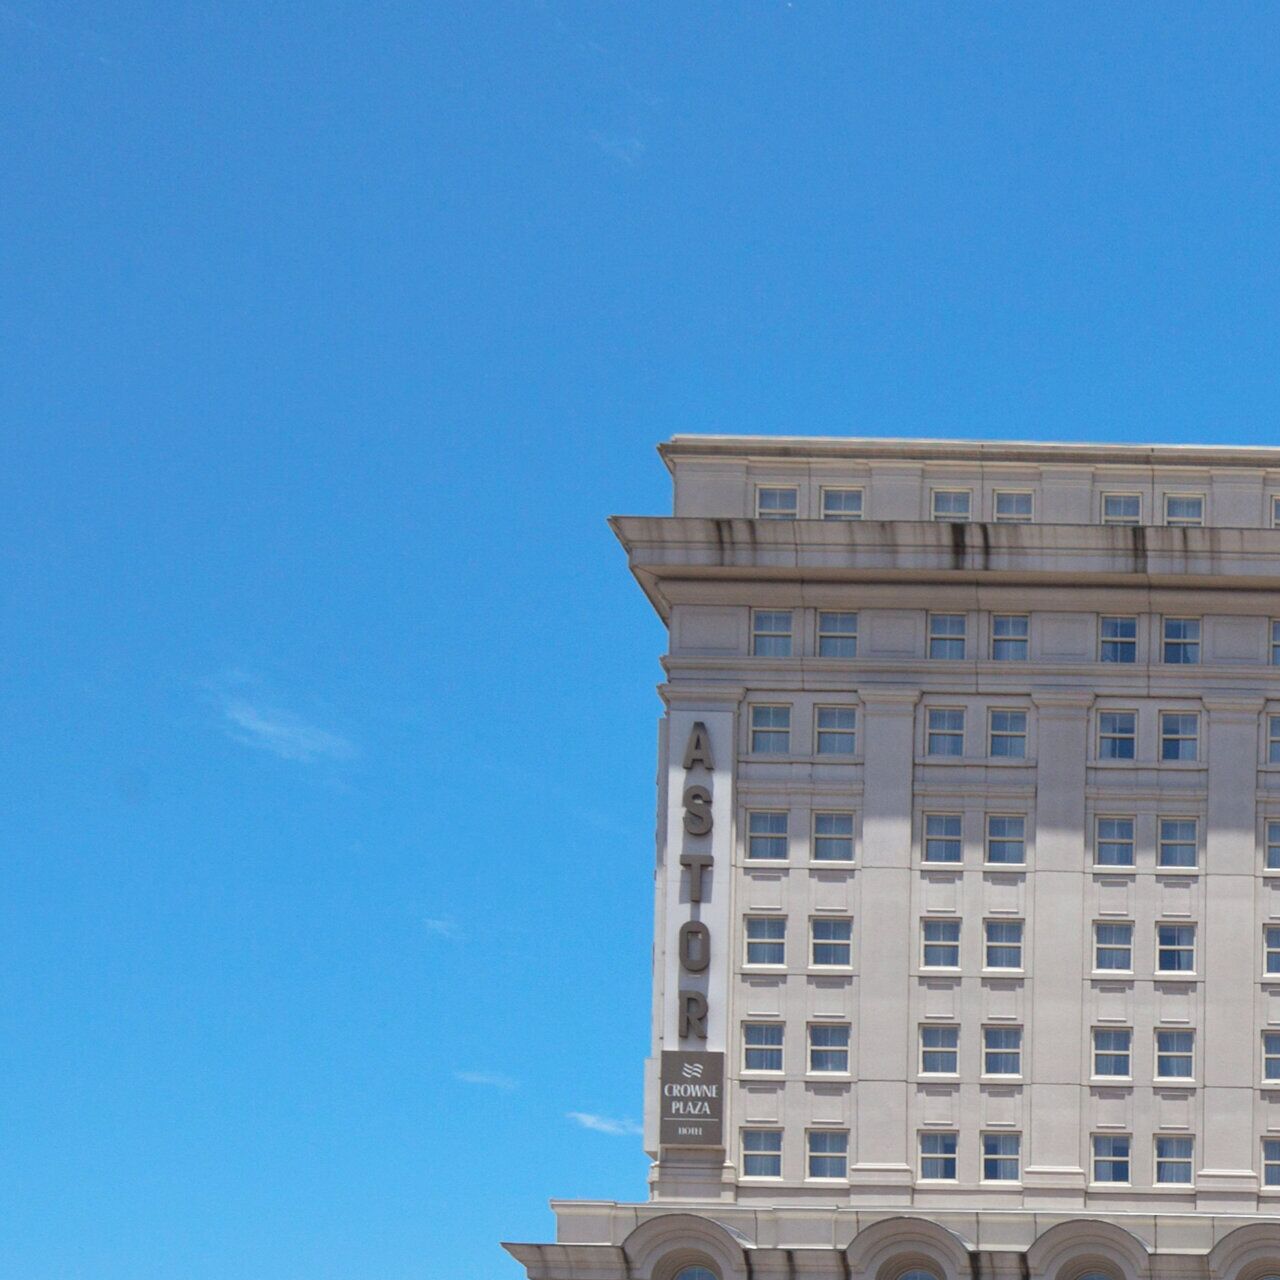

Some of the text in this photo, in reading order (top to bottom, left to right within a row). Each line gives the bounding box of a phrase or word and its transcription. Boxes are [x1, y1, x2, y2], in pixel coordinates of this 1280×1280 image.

[679, 721, 714, 1039] ASTOR
[664, 1083, 719, 1098] CROWNE
[671, 1101, 711, 1115] PLAZA
